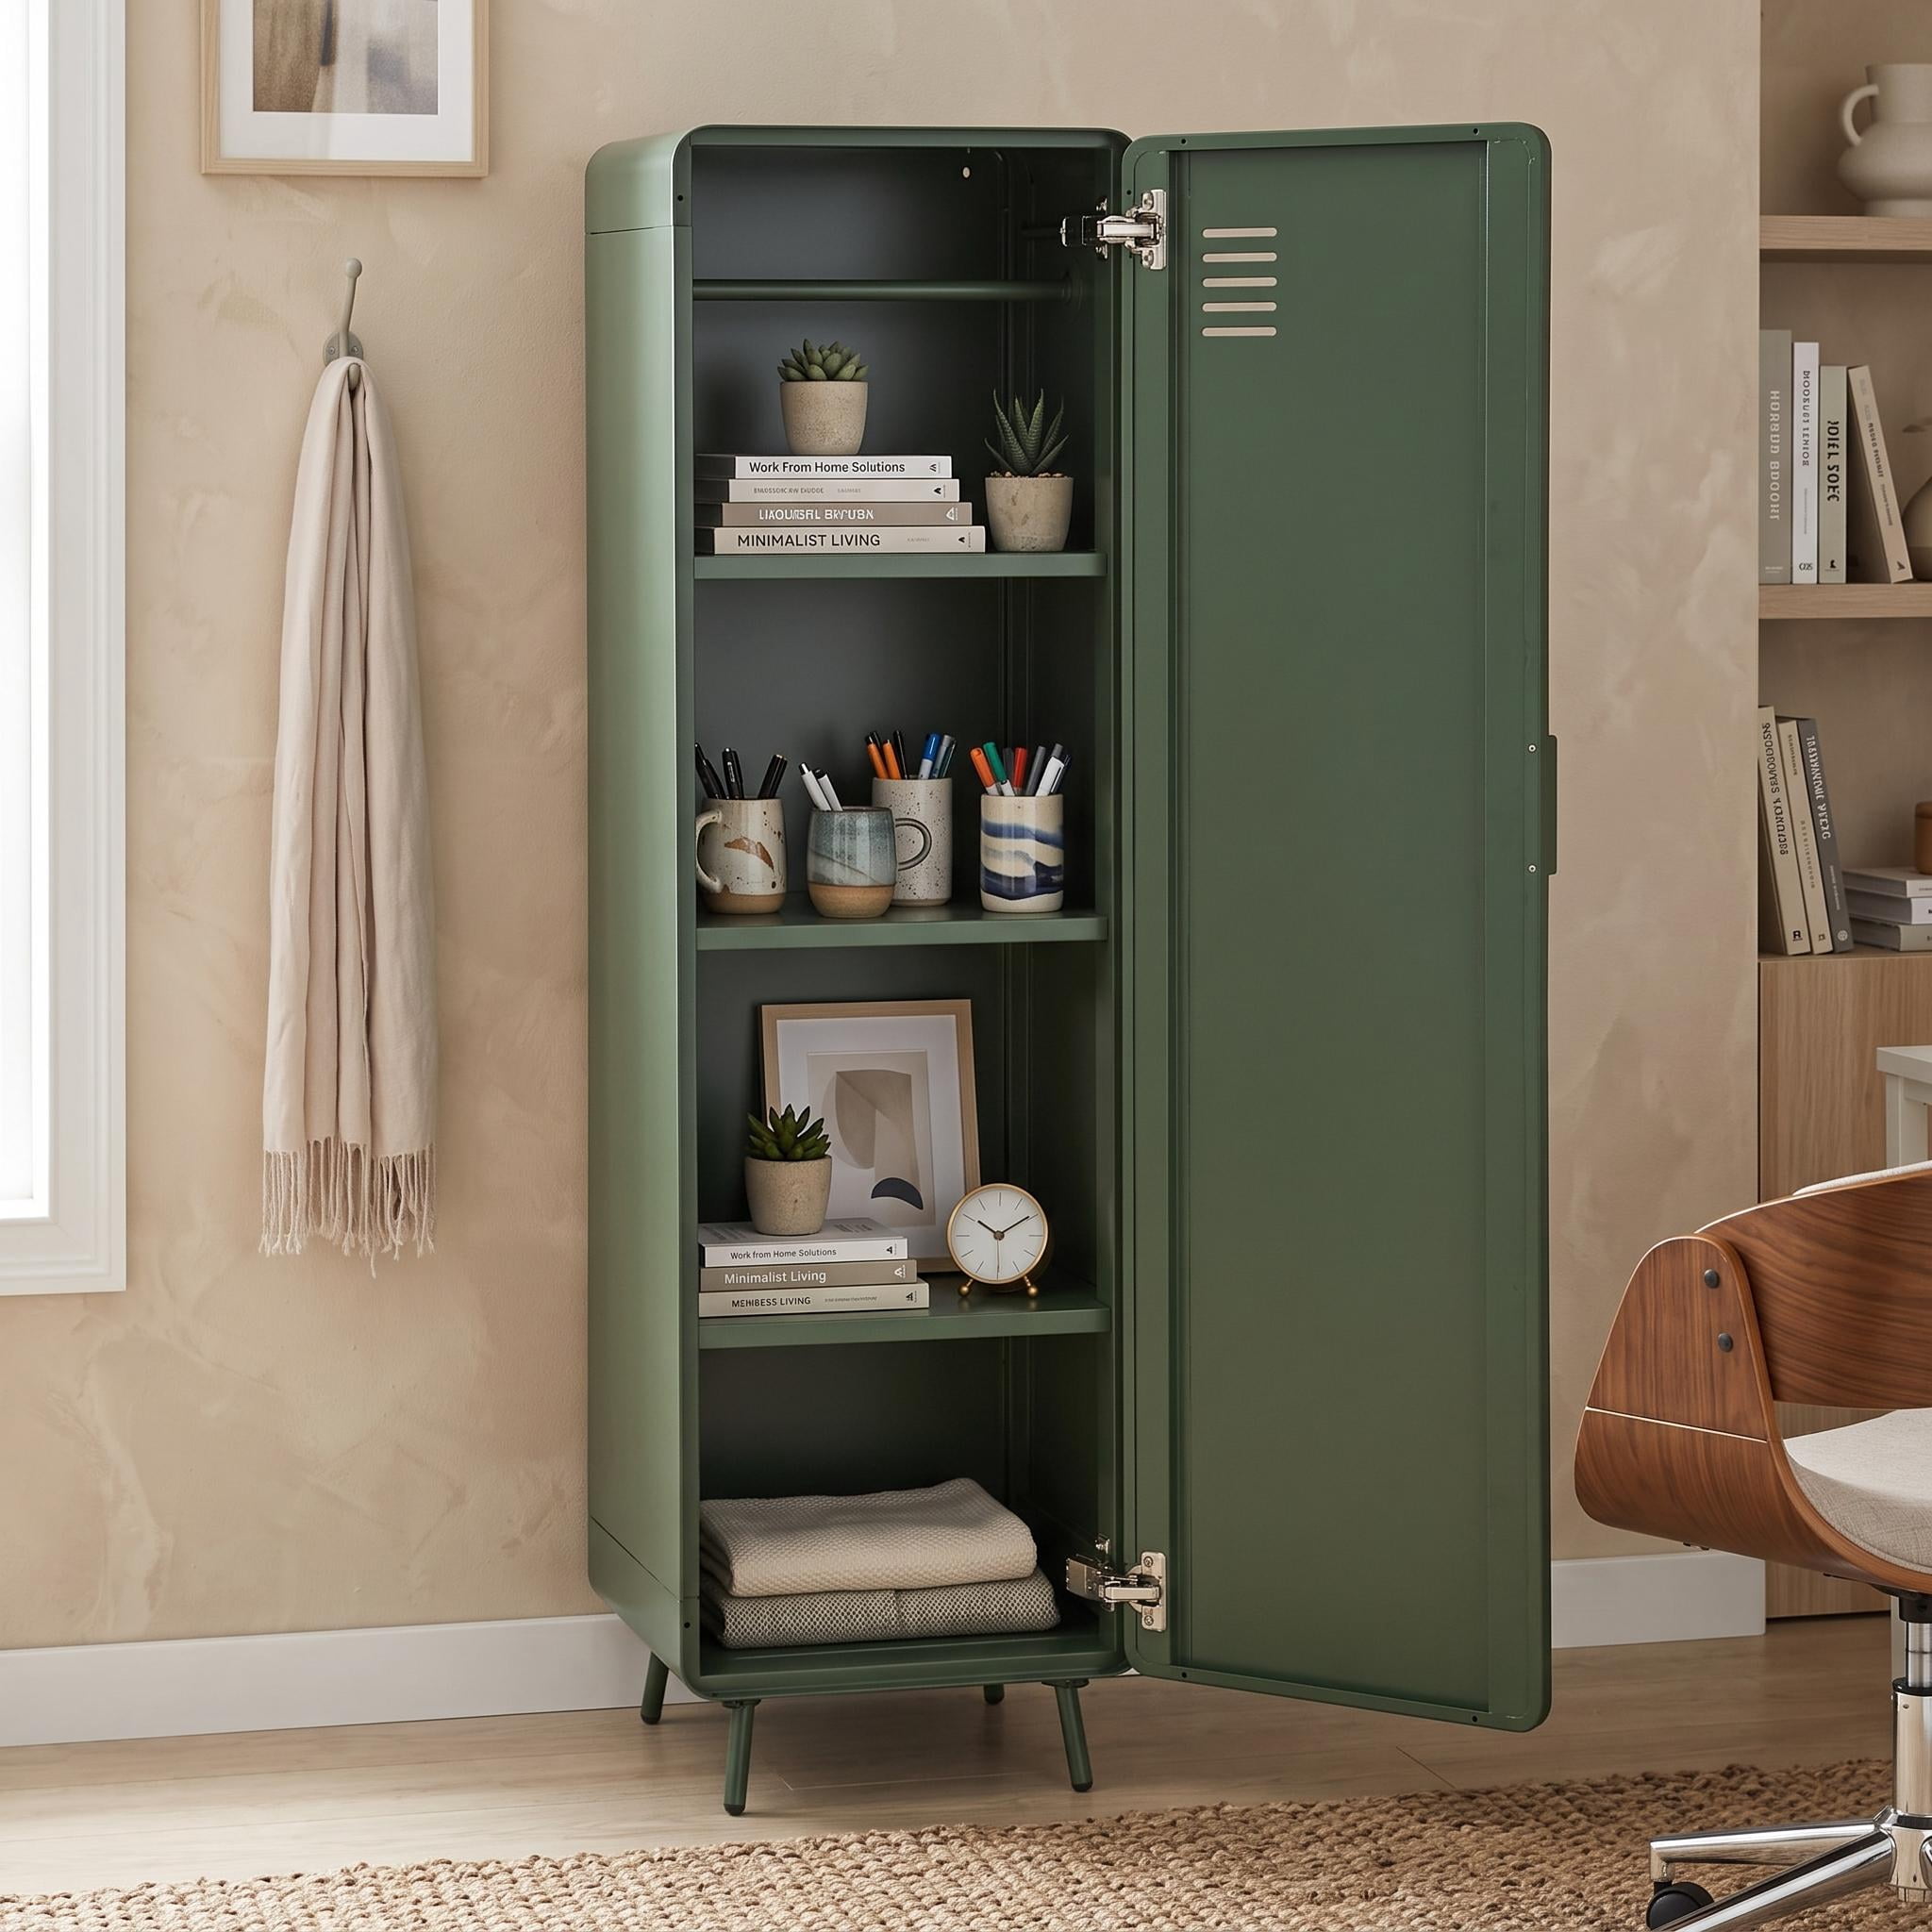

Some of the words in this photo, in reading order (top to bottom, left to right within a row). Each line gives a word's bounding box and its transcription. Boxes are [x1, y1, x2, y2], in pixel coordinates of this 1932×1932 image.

[749, 461, 780, 473] Work
[782, 461, 812, 473] From
[815, 461, 849, 473] Home
[852, 460, 906, 473] Solutions
[738, 534, 827, 547] MINIMALIST
[831, 534, 880, 547] LIVING
[730, 1251, 751, 1259] Work
[752, 1251, 772, 1259] from
[774, 1250, 797, 1258] Home
[799, 1248, 837, 1257] Solutions
[724, 1271, 788, 1284] Minimalist
[791, 1270, 826, 1284] Living
[779, 1296, 811, 1306] LIVING
